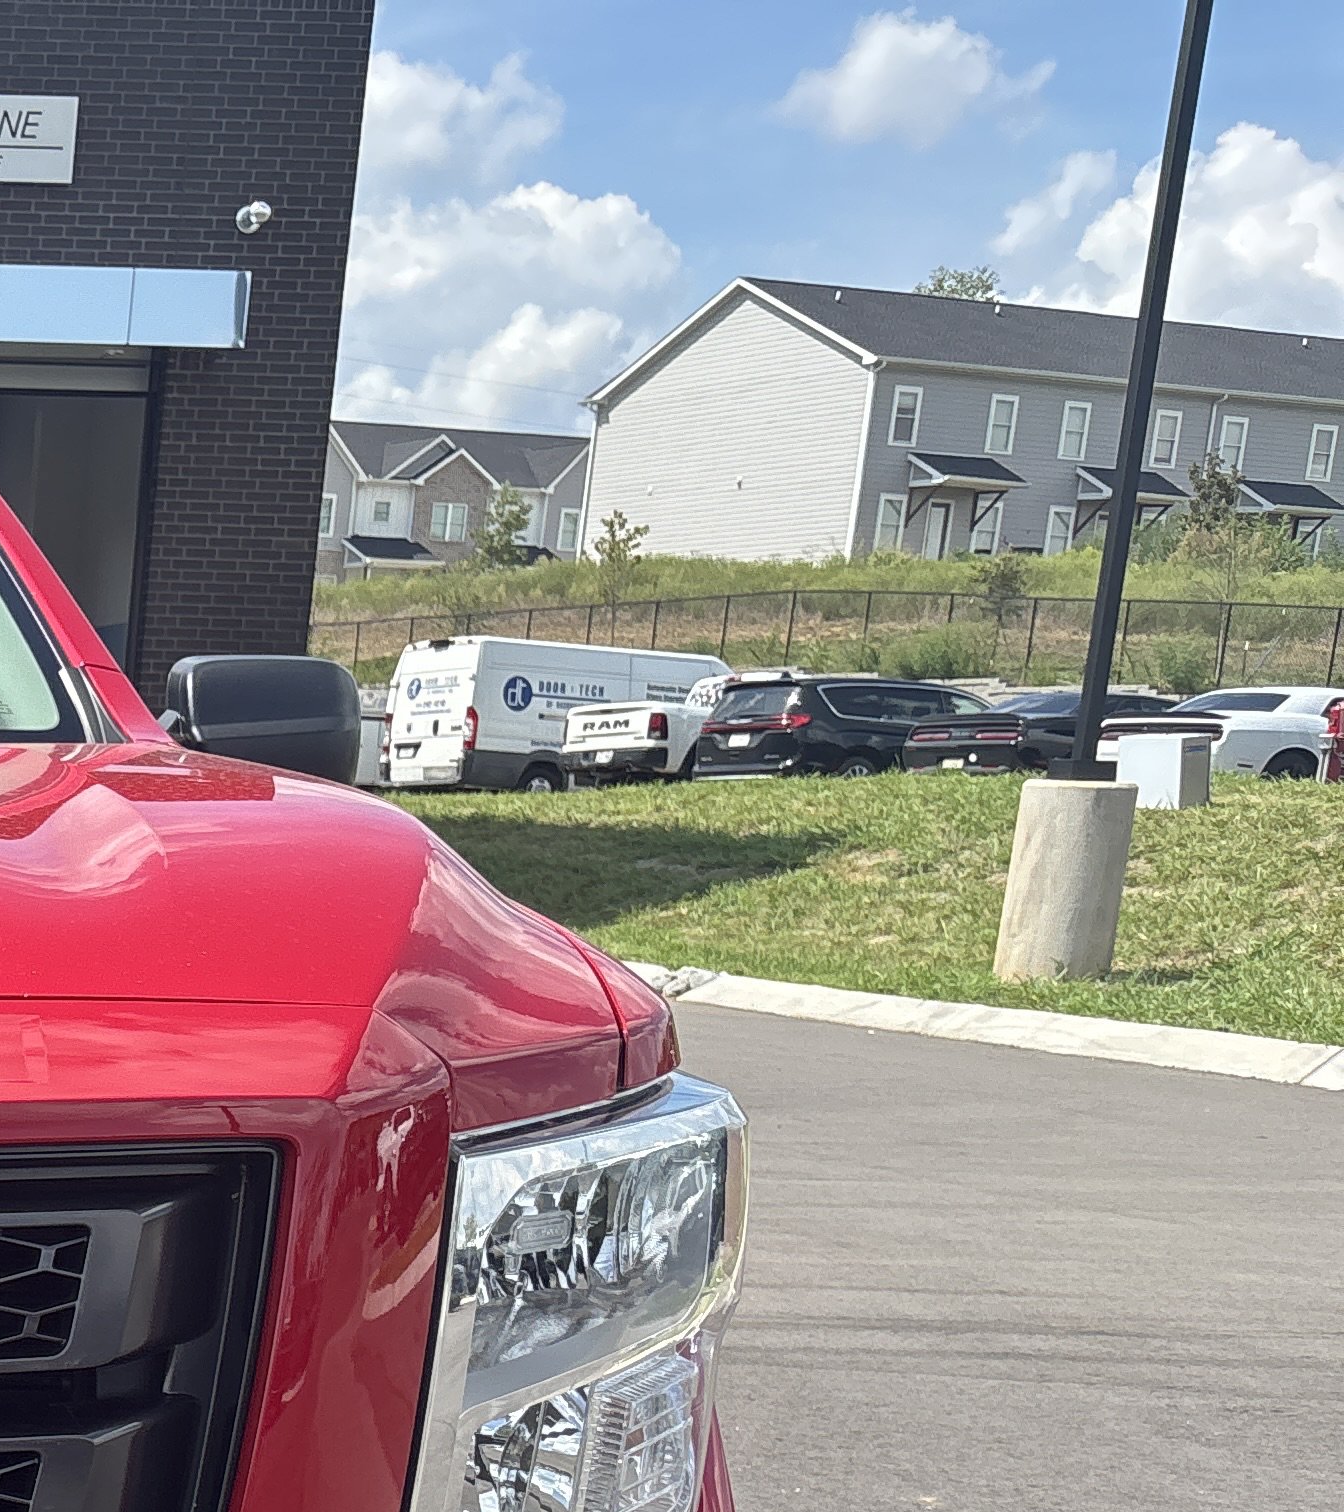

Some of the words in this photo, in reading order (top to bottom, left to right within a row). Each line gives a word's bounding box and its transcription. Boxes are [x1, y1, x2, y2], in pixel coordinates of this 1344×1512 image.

[538, 680, 566, 695] DOOR
[578, 683, 605, 698] TECH
[582, 718, 631, 732] RAM
